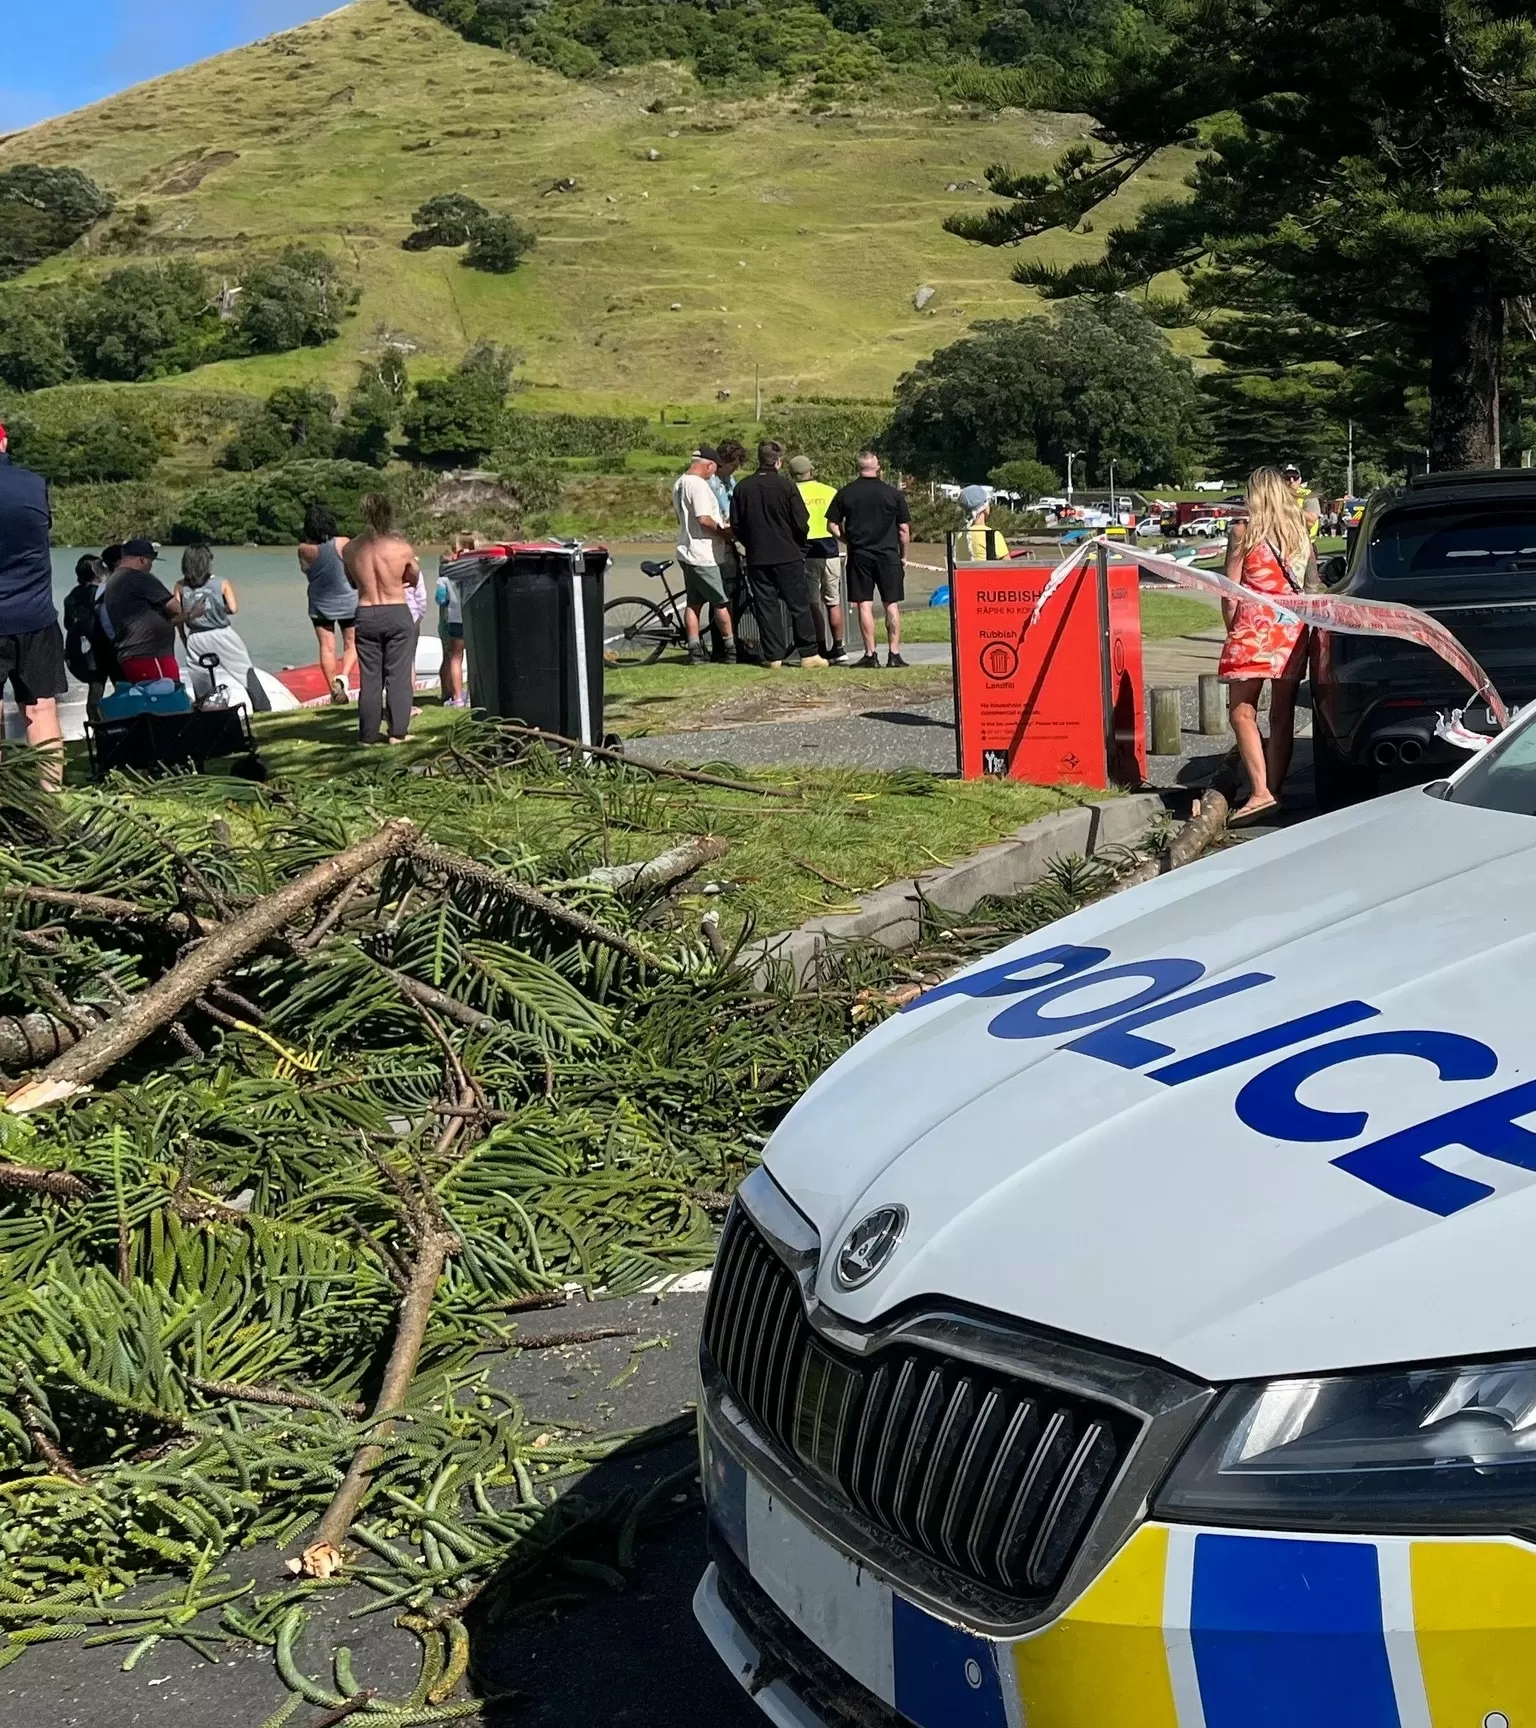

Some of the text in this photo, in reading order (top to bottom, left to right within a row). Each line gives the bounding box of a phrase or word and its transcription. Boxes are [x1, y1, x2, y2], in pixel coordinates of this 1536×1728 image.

[976, 590, 1042, 603] RUBBISH
[979, 630, 1018, 639] Rubbish
[985, 682, 1015, 690] Landfill
